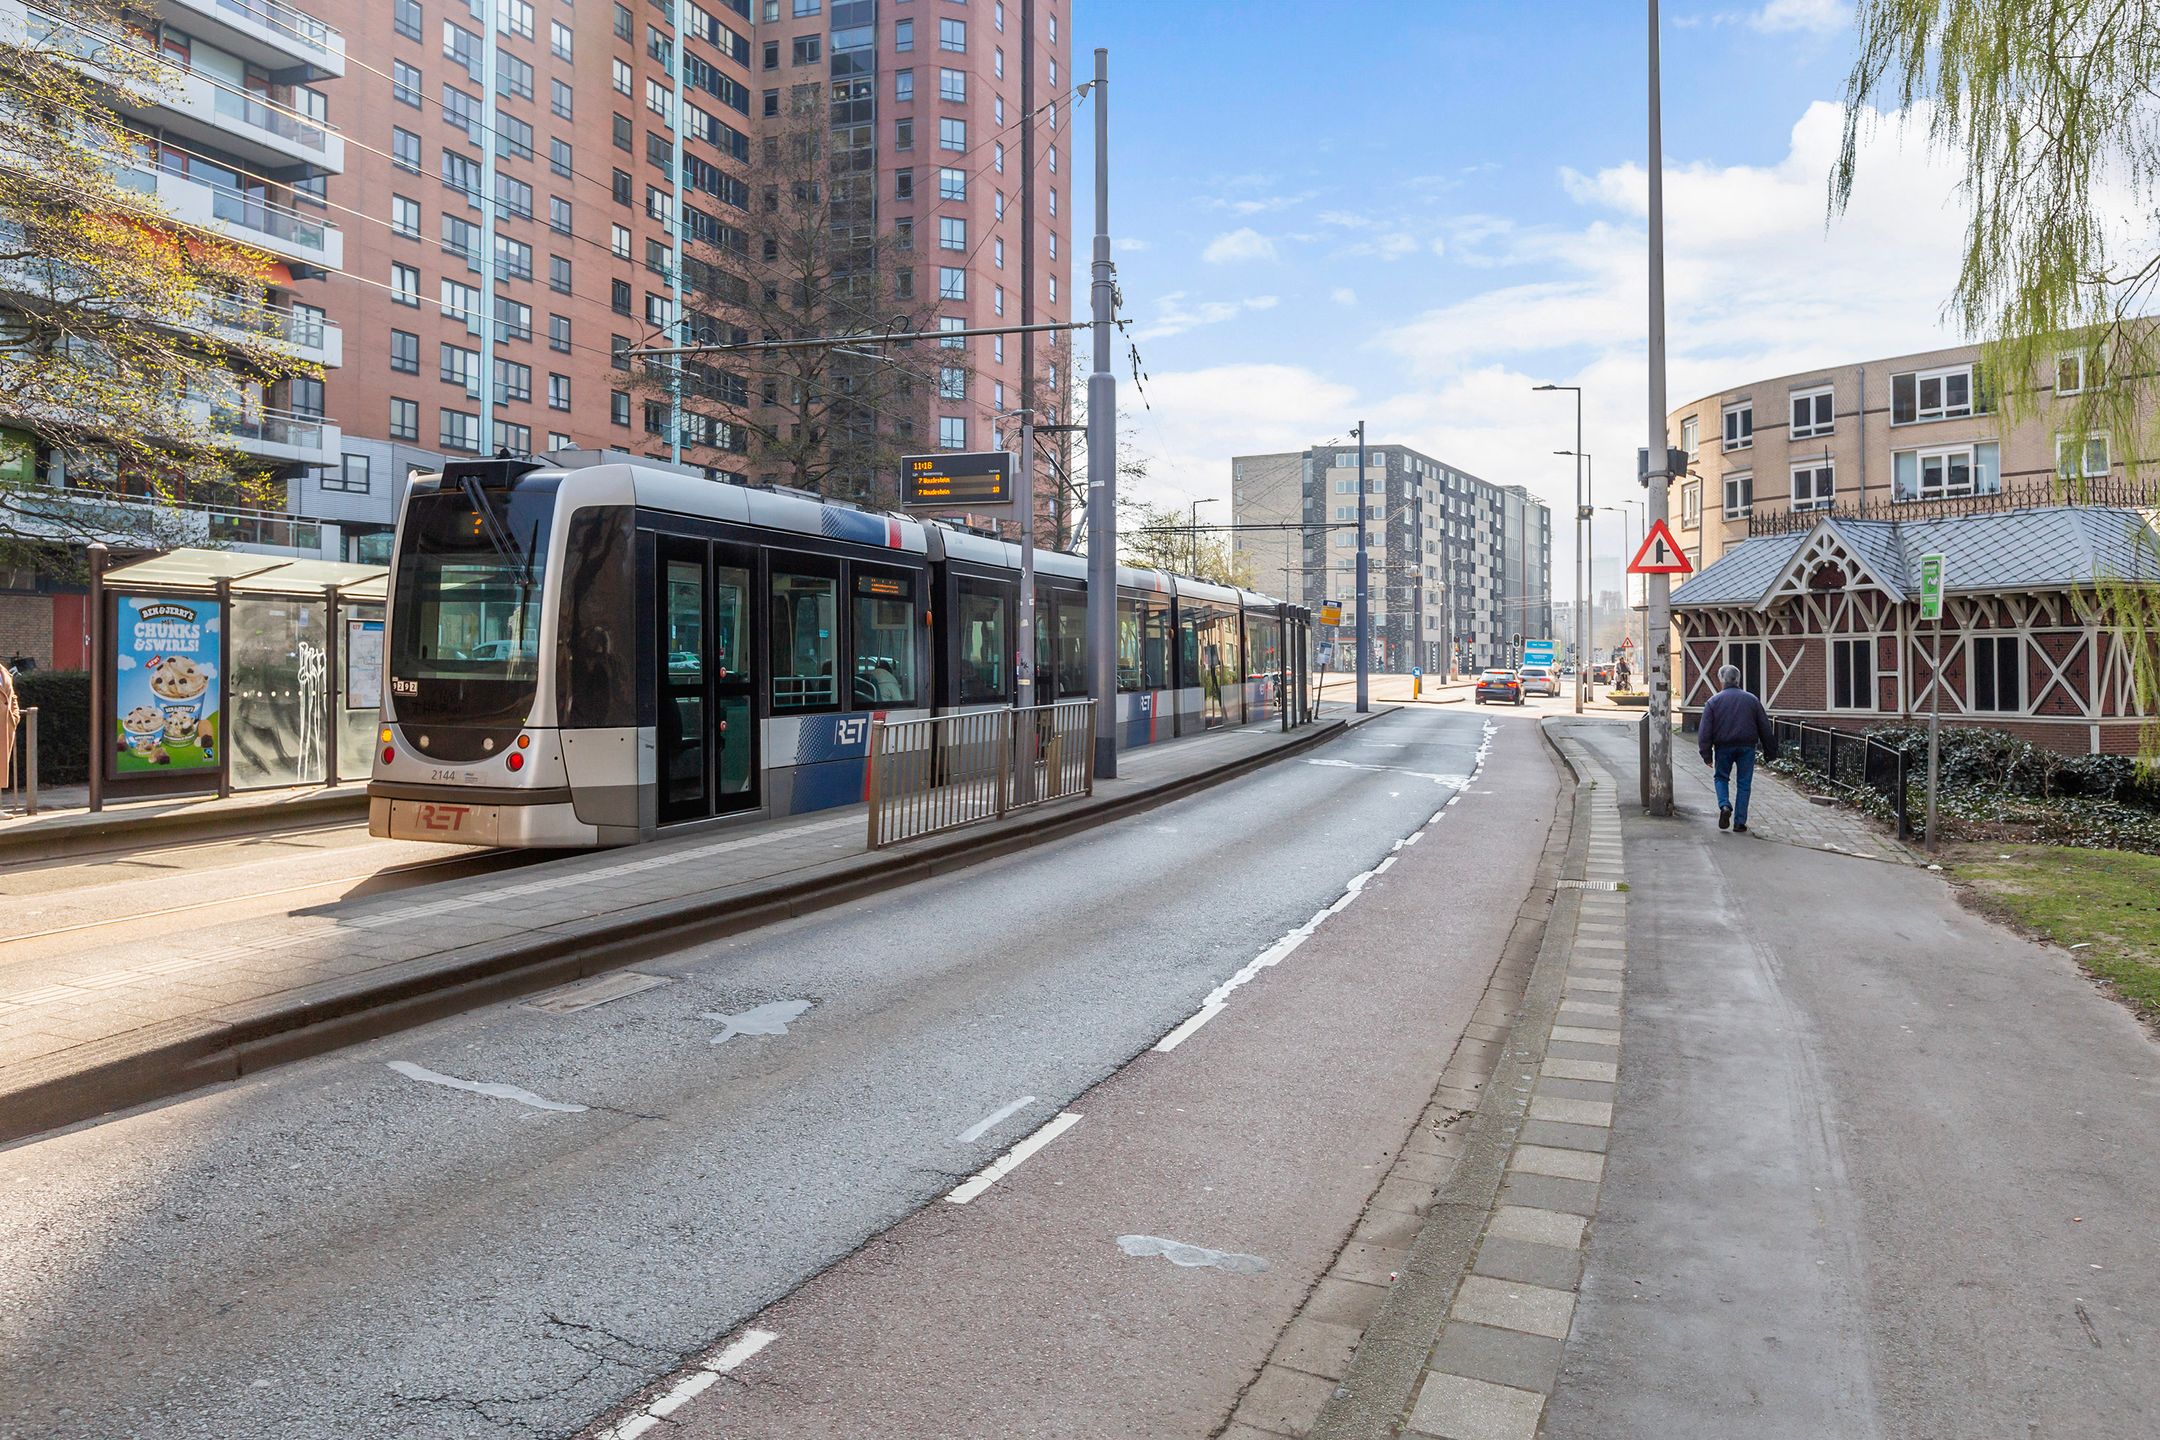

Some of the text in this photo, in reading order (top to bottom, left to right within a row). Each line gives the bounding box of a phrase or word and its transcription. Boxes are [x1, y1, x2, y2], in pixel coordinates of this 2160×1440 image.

[913, 461, 933, 470] 11:16
[165, 606, 195, 620] JERRY'S
[134, 622, 200, 638] CHUNKS
[834, 718, 867, 745] RET
[431, 769, 456, 781] 2144
[415, 804, 470, 831] RET
